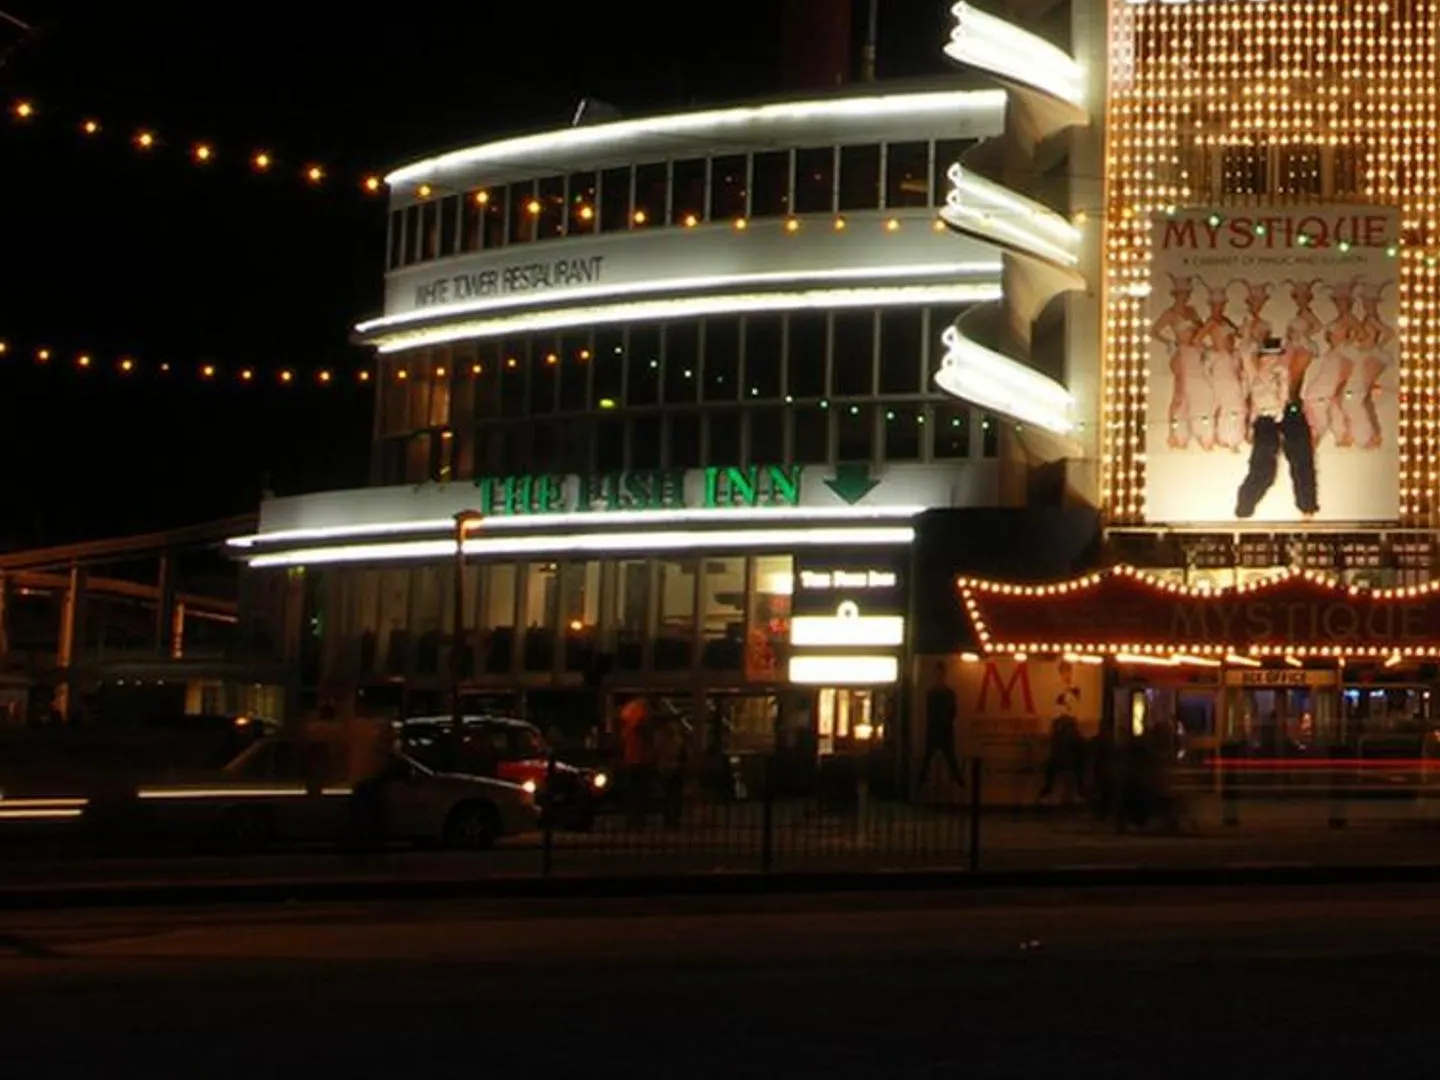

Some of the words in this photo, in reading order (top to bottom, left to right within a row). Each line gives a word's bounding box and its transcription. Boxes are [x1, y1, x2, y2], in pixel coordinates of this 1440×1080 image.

[1162, 215, 1391, 250] MYSTIQUE
[453, 270, 498, 300] TOWER
[502, 256, 604, 294] RESTAURANT
[476, 472, 563, 516] THE
[703, 465, 802, 510] INN
[1168, 601, 1429, 642] MYSTIQUE
[975, 660, 1037, 715] M
